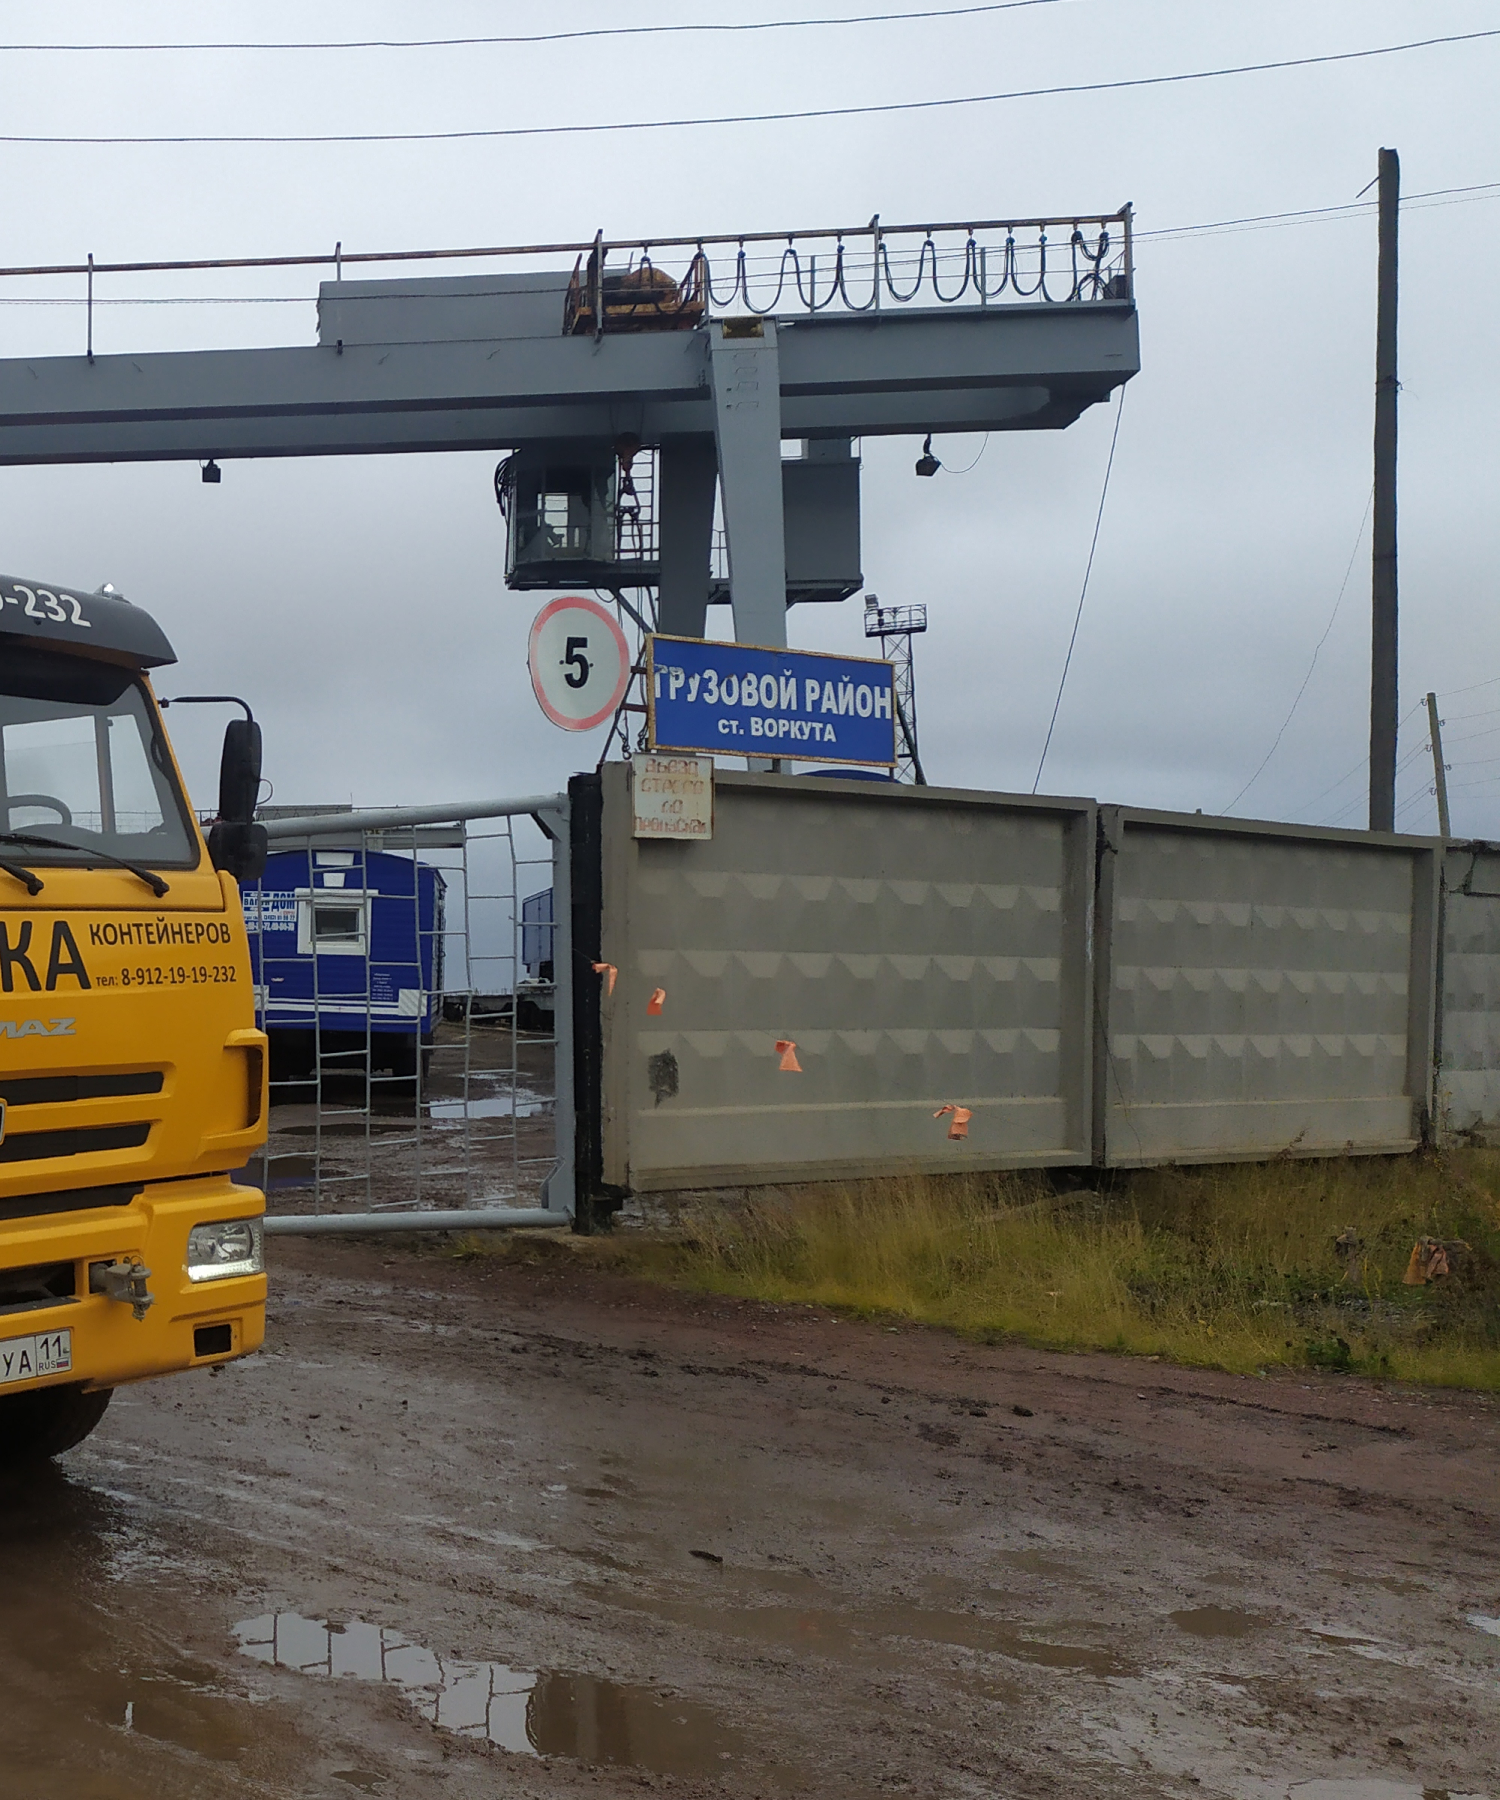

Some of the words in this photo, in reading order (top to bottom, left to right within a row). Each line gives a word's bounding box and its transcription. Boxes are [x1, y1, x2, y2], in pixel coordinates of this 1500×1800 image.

[564, 637, 589, 689] 5
[805, 675, 892, 720] РАЙОН
[718, 719, 744, 735] ст.
[750, 717, 837, 743] ВОРКУТА
[89, 916, 232, 946] КОНТЕЙНЕРОВ
[95, 972, 119, 988] тел:
[122, 964, 237, 988] 8-912-19-19-232
[40, 1335, 62, 1360] 11
[38, 1360, 56, 1371] RUS
